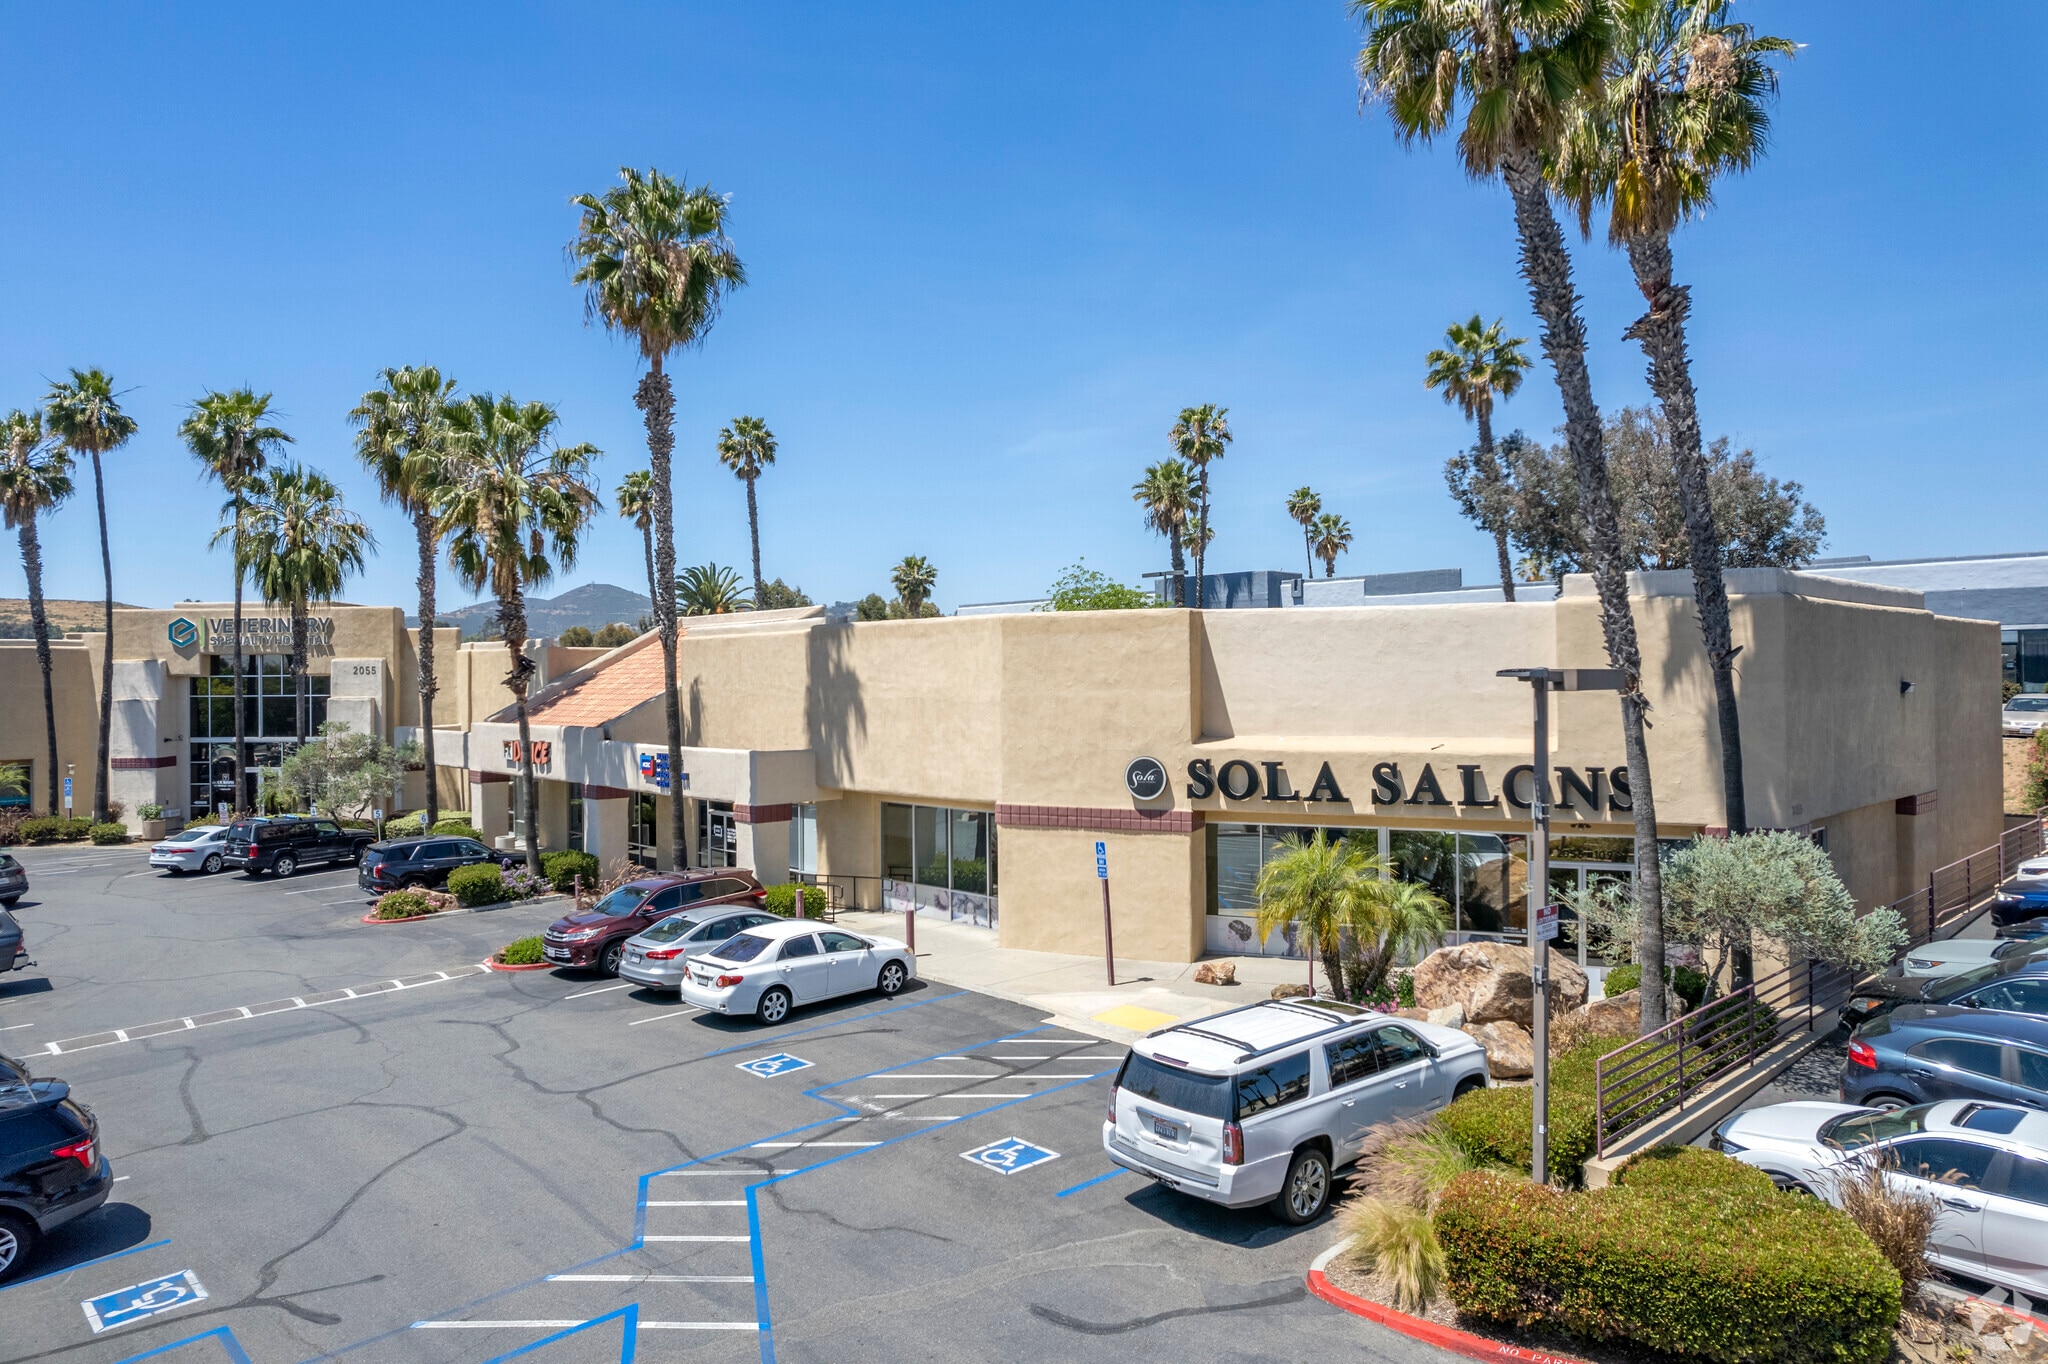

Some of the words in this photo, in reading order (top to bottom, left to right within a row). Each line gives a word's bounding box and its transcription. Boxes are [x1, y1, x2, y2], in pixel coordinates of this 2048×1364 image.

[210, 617, 331, 634] VETERINRY
[210, 635, 272, 646] SPEIALTY
[353, 666, 377, 675] 2055
[1130, 768, 1161, 789] Sola
[1187, 758, 1350, 803] SOLA
[1371, 762, 1634, 812] SALONS
[375, 811, 381, 819] 5
[421, 815, 427, 823] 6
[1499, 1345, 1519, 1356] NO
